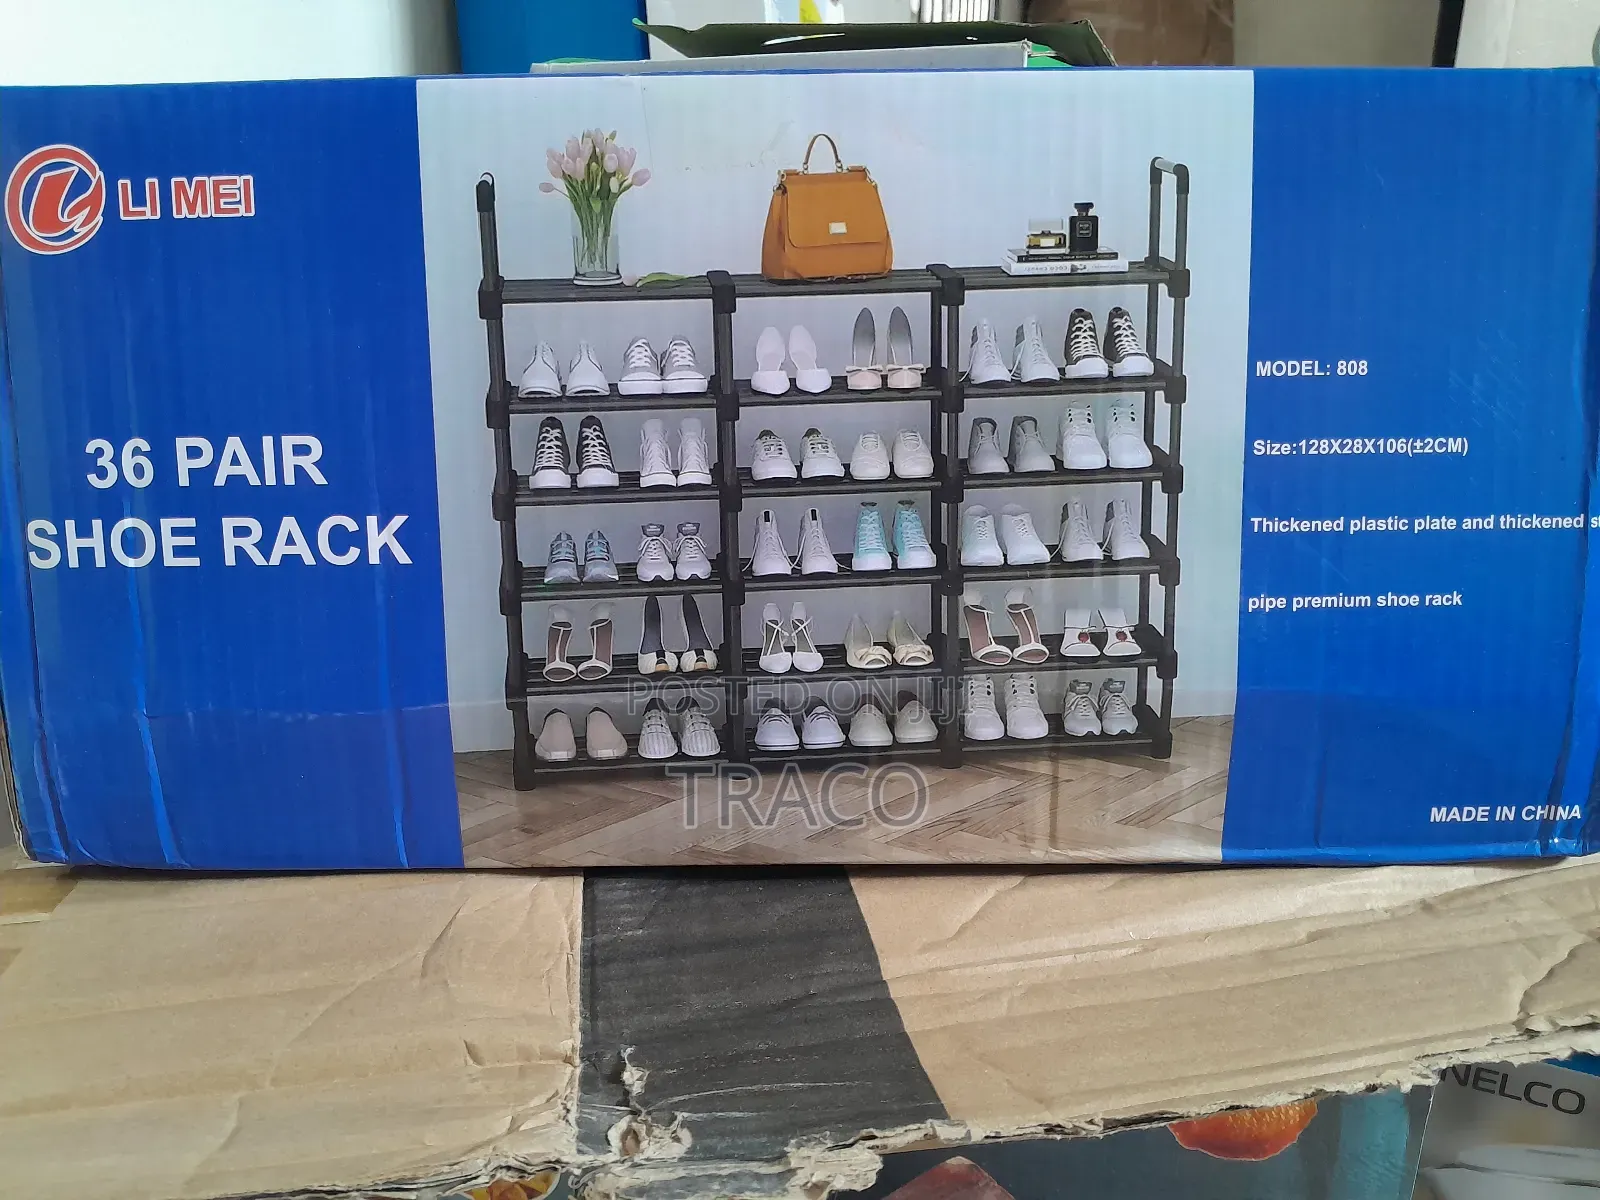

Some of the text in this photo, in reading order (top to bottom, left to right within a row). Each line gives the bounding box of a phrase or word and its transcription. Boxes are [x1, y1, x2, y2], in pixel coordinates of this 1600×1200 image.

[117, 175, 255, 220] LI MEI
[1256, 360, 1368, 377] MODEL: 808
[85, 435, 328, 488] 36 PAIR
[1250, 516, 1344, 533] Thickened
[1349, 515, 1409, 535] plastic
[1413, 515, 1457, 534] plate
[1461, 514, 1495, 530] and
[1500, 513, 1585, 529] thickened
[27, 515, 413, 569] SHOE RACK
[1248, 590, 1463, 612] pipe premium shoe rack
[1430, 803, 1582, 823] MADE IN CHINA
